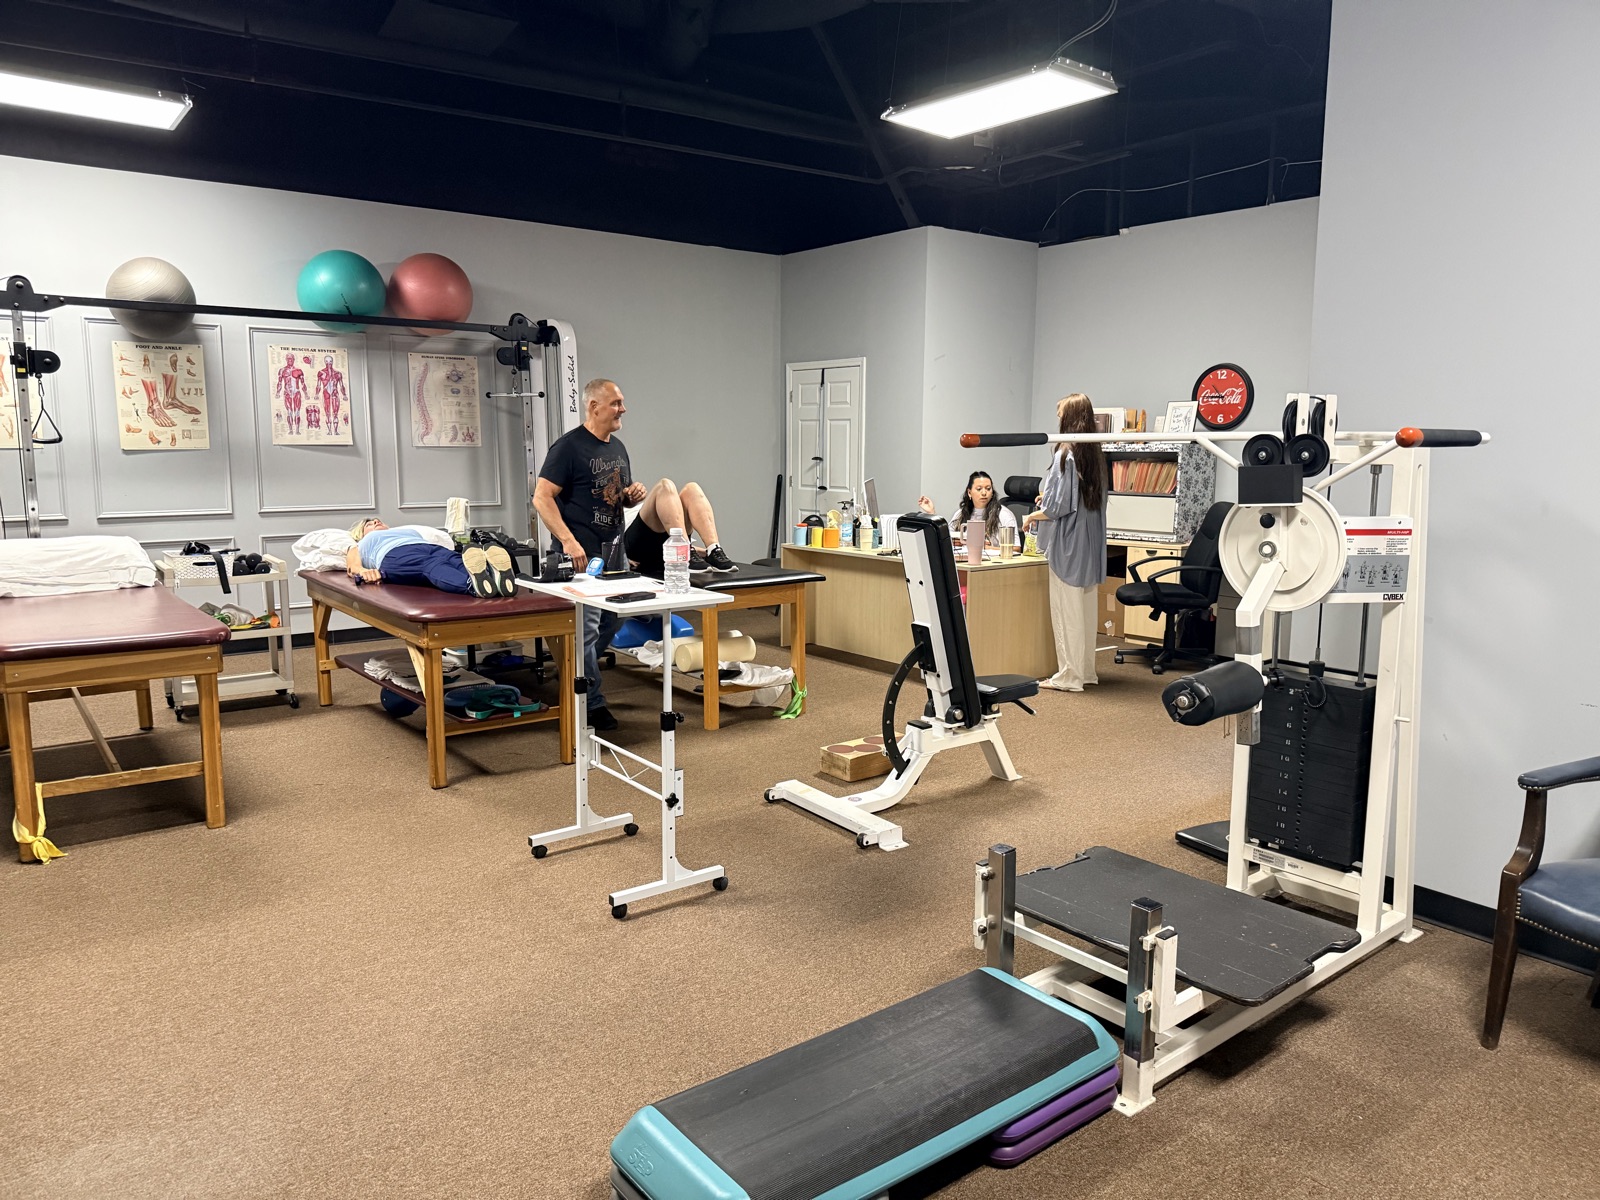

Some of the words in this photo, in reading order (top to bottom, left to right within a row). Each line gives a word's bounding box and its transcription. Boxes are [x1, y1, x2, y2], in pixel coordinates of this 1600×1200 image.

[1216, 370, 1227, 380] 12
[567, 355, 578, 413] Body-Solid
[1216, 414, 1224, 423] 6
[594, 512, 613, 525] RIDE
[1382, 593, 1404, 601] CYBEX
[1274, 837, 1285, 845] 20
